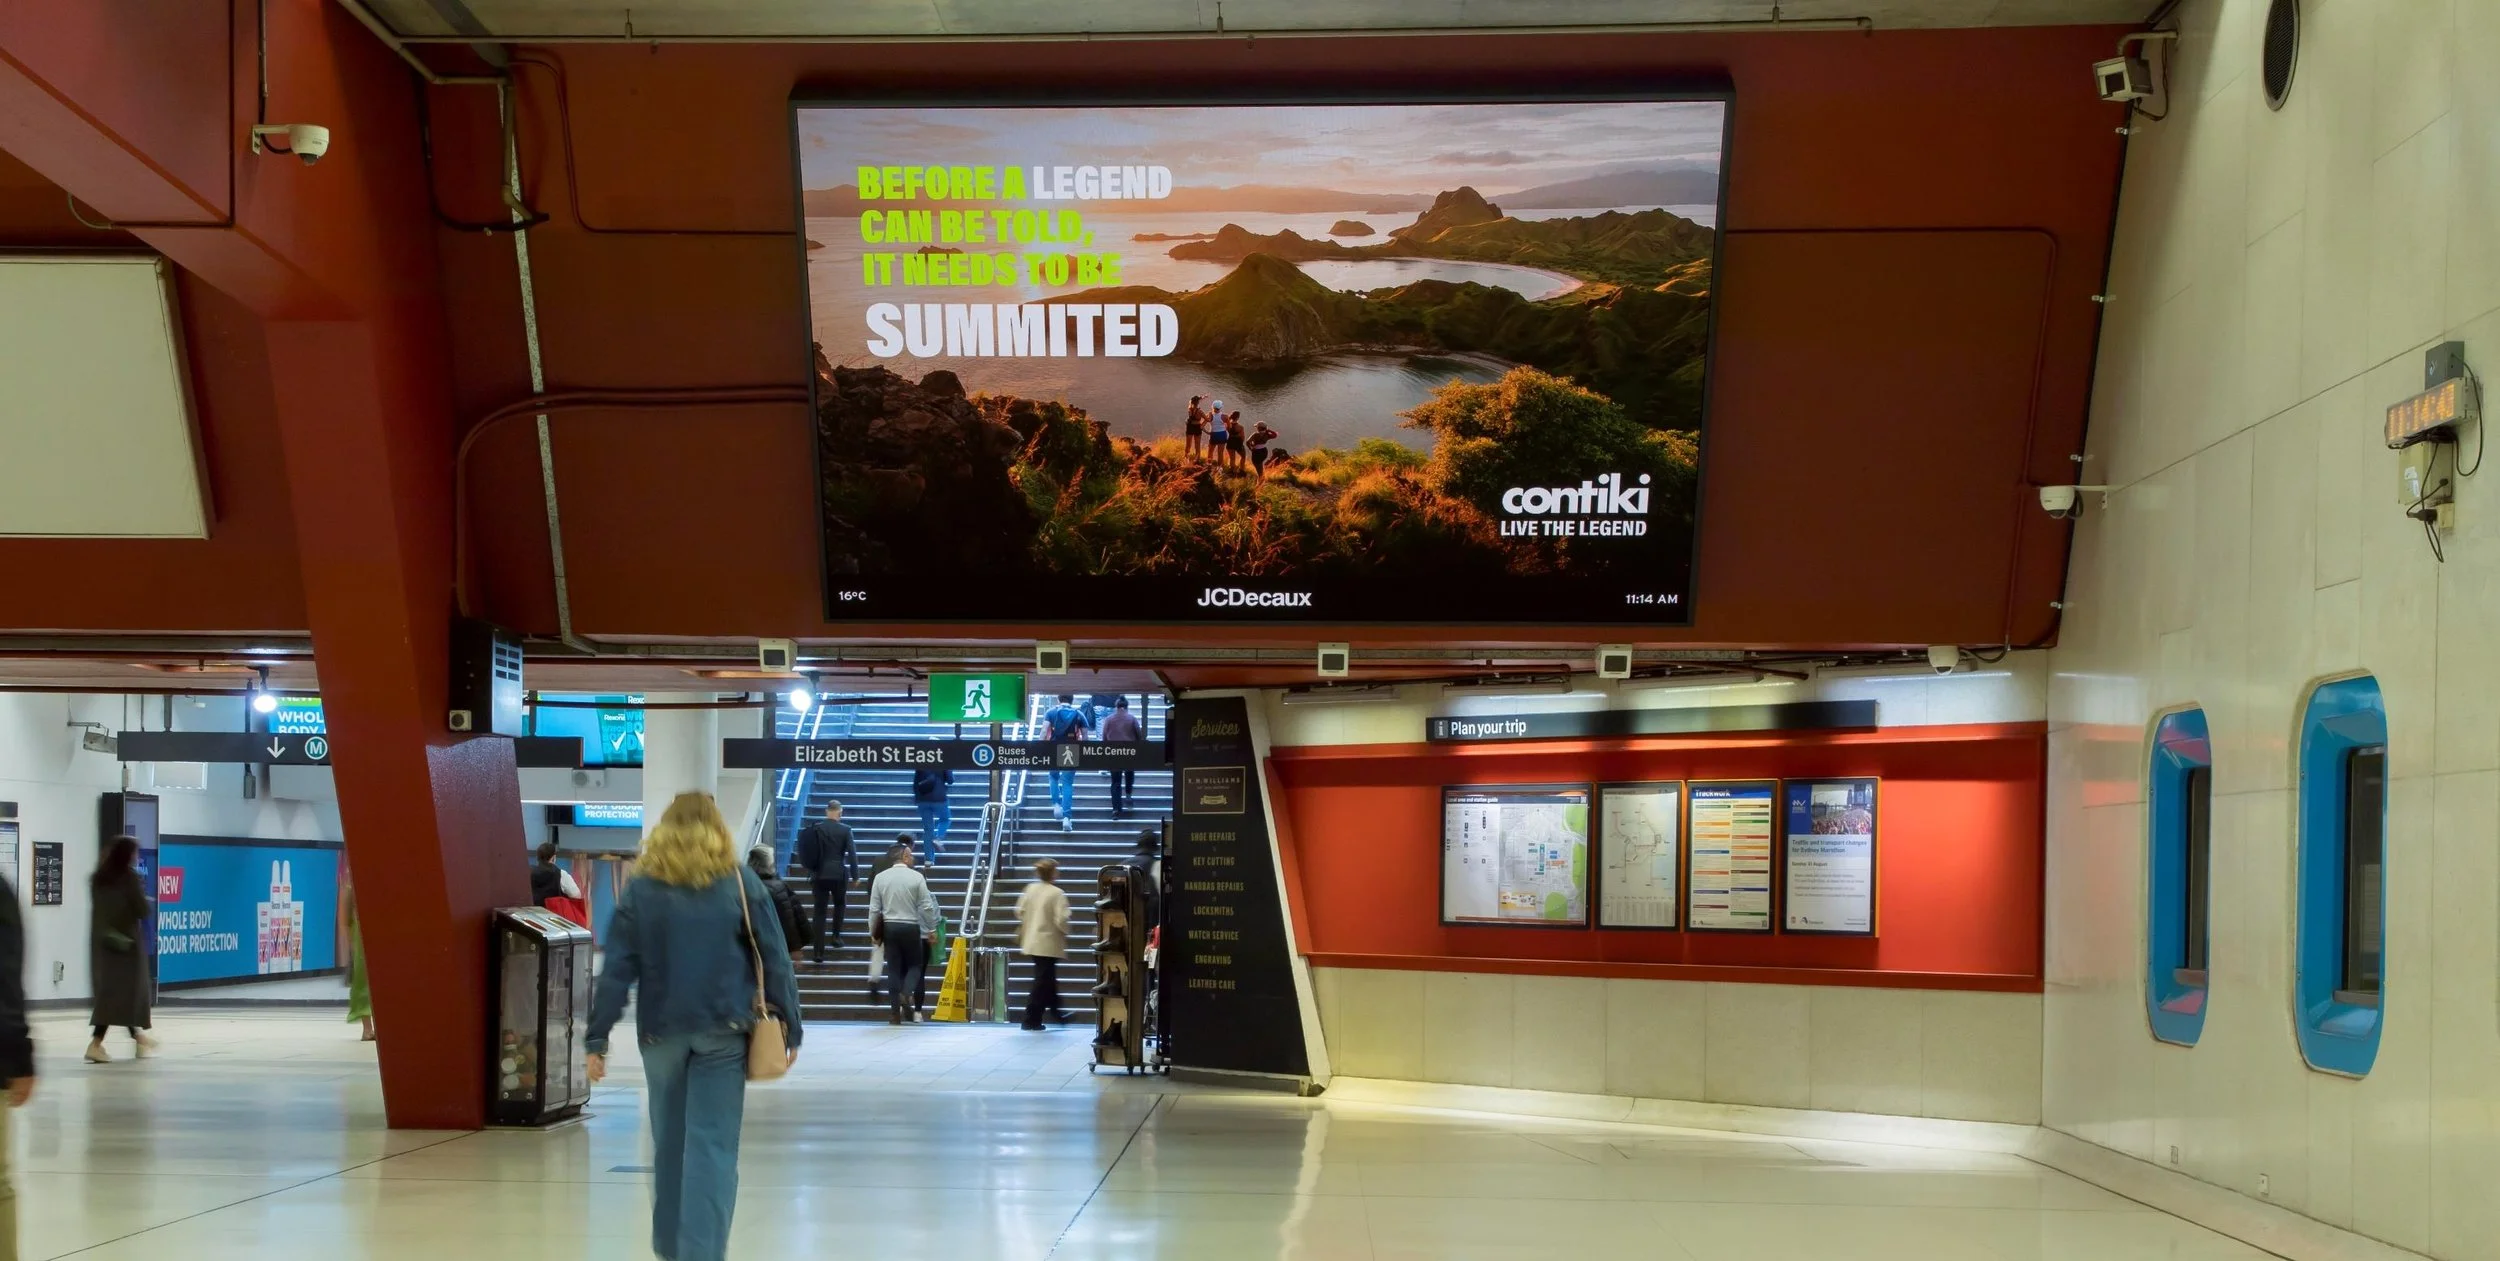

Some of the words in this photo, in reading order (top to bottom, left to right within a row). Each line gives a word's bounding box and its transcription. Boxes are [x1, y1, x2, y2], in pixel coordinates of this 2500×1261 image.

[857, 166, 995, 200] BEFORE
[1002, 166, 1027, 200] A
[1033, 166, 1173, 200] LEGEND
[860, 209, 932, 243] CAN
[940, 210, 985, 243] BE
[992, 209, 1095, 247] TOLD,
[863, 253, 895, 286] IT
[903, 253, 1018, 286] NEEDS
[1022, 254, 1069, 286] TO
[1077, 254, 1122, 286] BE
[866, 302, 1179, 358] SUMMITED
[1502, 473, 1651, 514] contiki
[1501, 520, 1538, 536] LIVE
[1542, 520, 1575, 536] THE
[1579, 520, 1647, 536] LEGEND
[1197, 588, 1312, 606] JCDecaux
[1625, 594, 1653, 604] 11:14
[1657, 594, 1678, 604] AM
[277, 711, 325, 723] WHOL
[1190, 719, 1240, 740] Services
[1451, 721, 1475, 735] Plan
[1477, 723, 1503, 738] your
[1505, 719, 1526, 736] trip
[795, 746, 877, 762] Elizabeth
[882, 746, 900, 762] St
[905, 747, 943, 763] East
[998, 746, 1026, 755] Buses
[1083, 746, 1103, 756] MLC
[1105, 747, 1136, 756] Centre
[998, 756, 1030, 765] Stands
[585, 810, 639, 819] PROTECTION
[1191, 832, 1207, 841] SHOE
[1208, 832, 1236, 841] REPAIRS
[1193, 857, 1205, 866] KEY
[1207, 857, 1235, 866] CUTTING
[159, 876, 179, 894] NEW
[1216, 882, 1244, 892] REPAIRS
[1193, 906, 1234, 916] LOCKSMITHS
[158, 911, 188, 930] WHOLE
[190, 911, 213, 929] BODY
[1188, 930, 1210, 940] WATCH
[1212, 931, 1239, 940] SERVICE
[190, 933, 238, 953] PROTECTION
[1195, 955, 1231, 964] ENGRAVING
[1189, 979, 1217, 989] LEATHER
[1219, 980, 1236, 990] CARE
